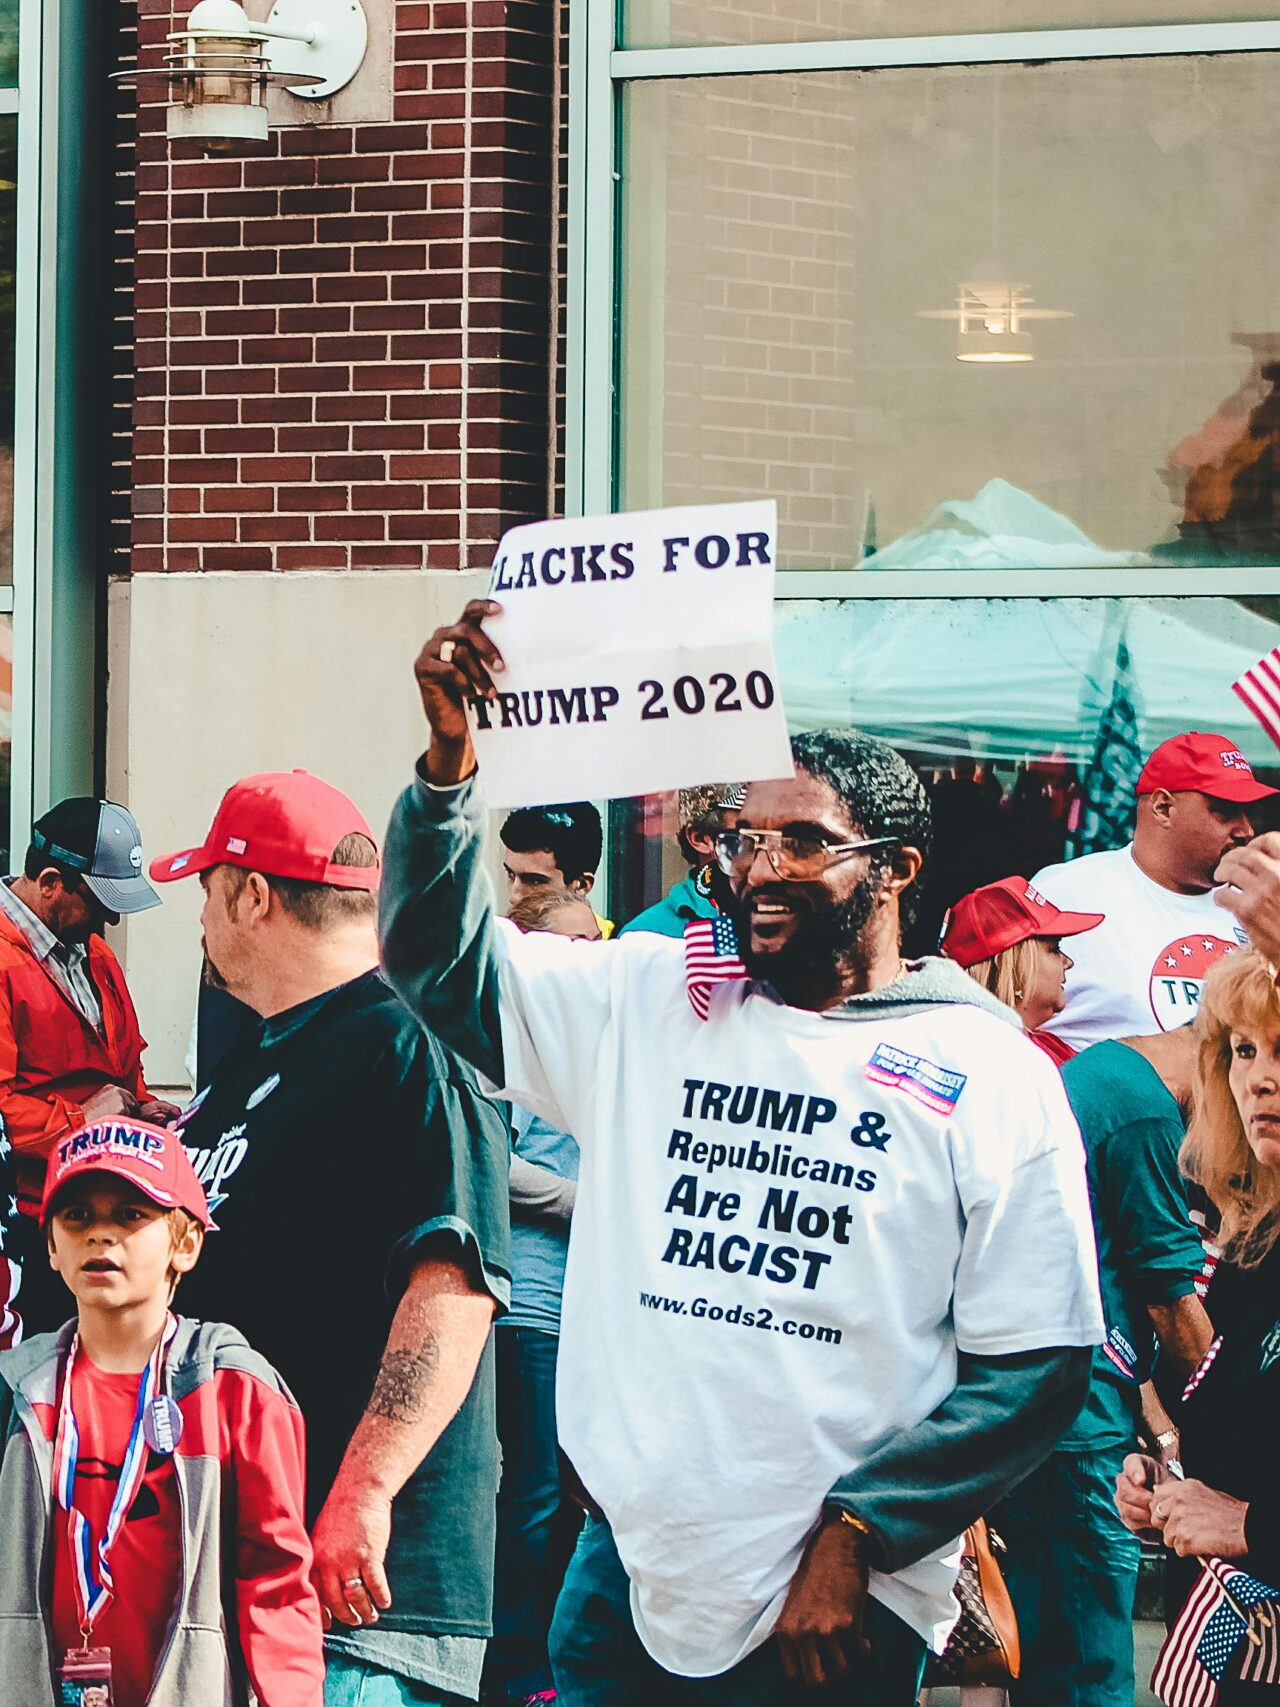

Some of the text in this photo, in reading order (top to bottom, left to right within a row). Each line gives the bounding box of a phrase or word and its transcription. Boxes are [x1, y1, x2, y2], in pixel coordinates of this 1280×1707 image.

[488, 531, 773, 592] LACKS FOR
[467, 669, 775, 730] TRUMP 2020
[58, 1125, 163, 1164] TRUMP
[682, 1078, 893, 1154] TRUMP &
[666, 1128, 878, 1193] Republicans
[664, 1173, 854, 1245] Are Not
[661, 1227, 833, 1290] RACIST
[639, 1290, 843, 1345] www.Gods2.com
[154, 1397, 174, 1453] TRUMP
